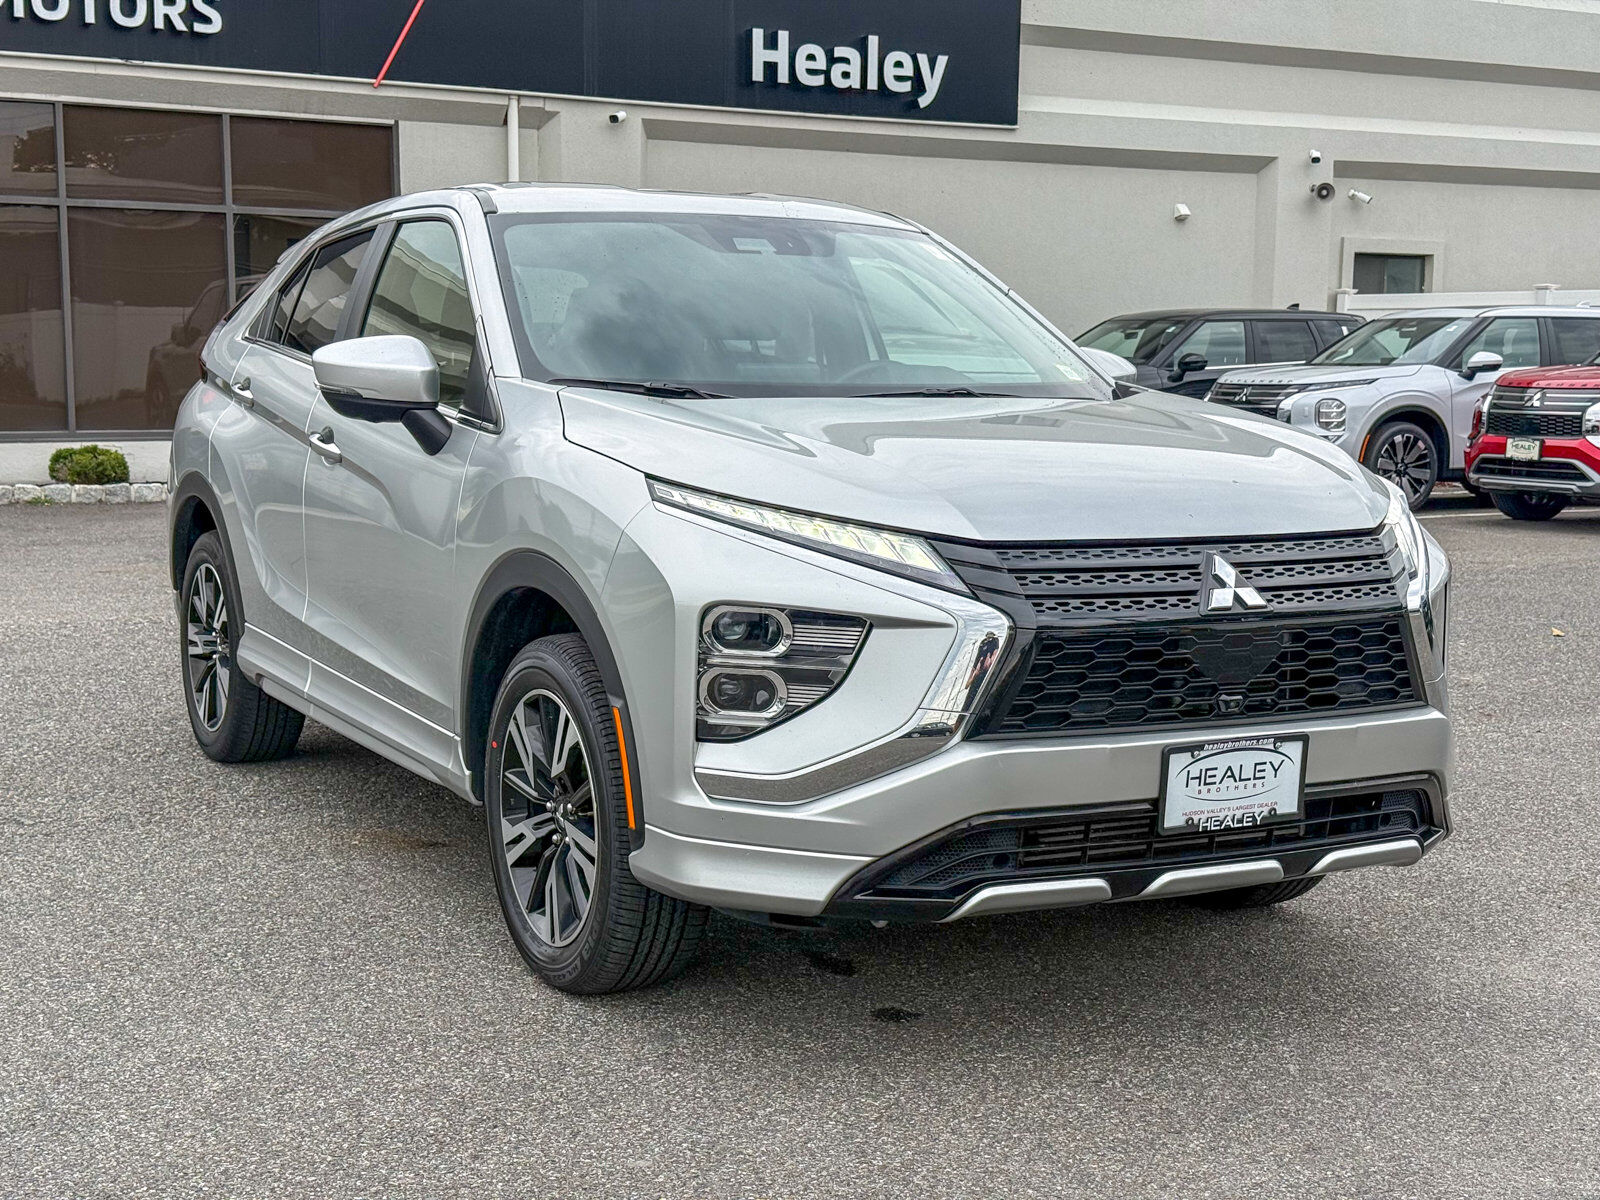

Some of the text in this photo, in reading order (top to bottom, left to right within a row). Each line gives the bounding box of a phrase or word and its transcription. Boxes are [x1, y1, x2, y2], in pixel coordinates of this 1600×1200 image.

[0, 0, 223, 34] TORS
[751, 27, 949, 109] Healey
[1203, 738, 1275, 751] healeybrothers.com
[1185, 759, 1286, 788] HEALEY
[1197, 781, 1266, 795] BROTHERS
[1181, 801, 1278, 817] HUDSON VALLEY'S LARGEST DEALER
[1198, 812, 1265, 832] HEALEY
